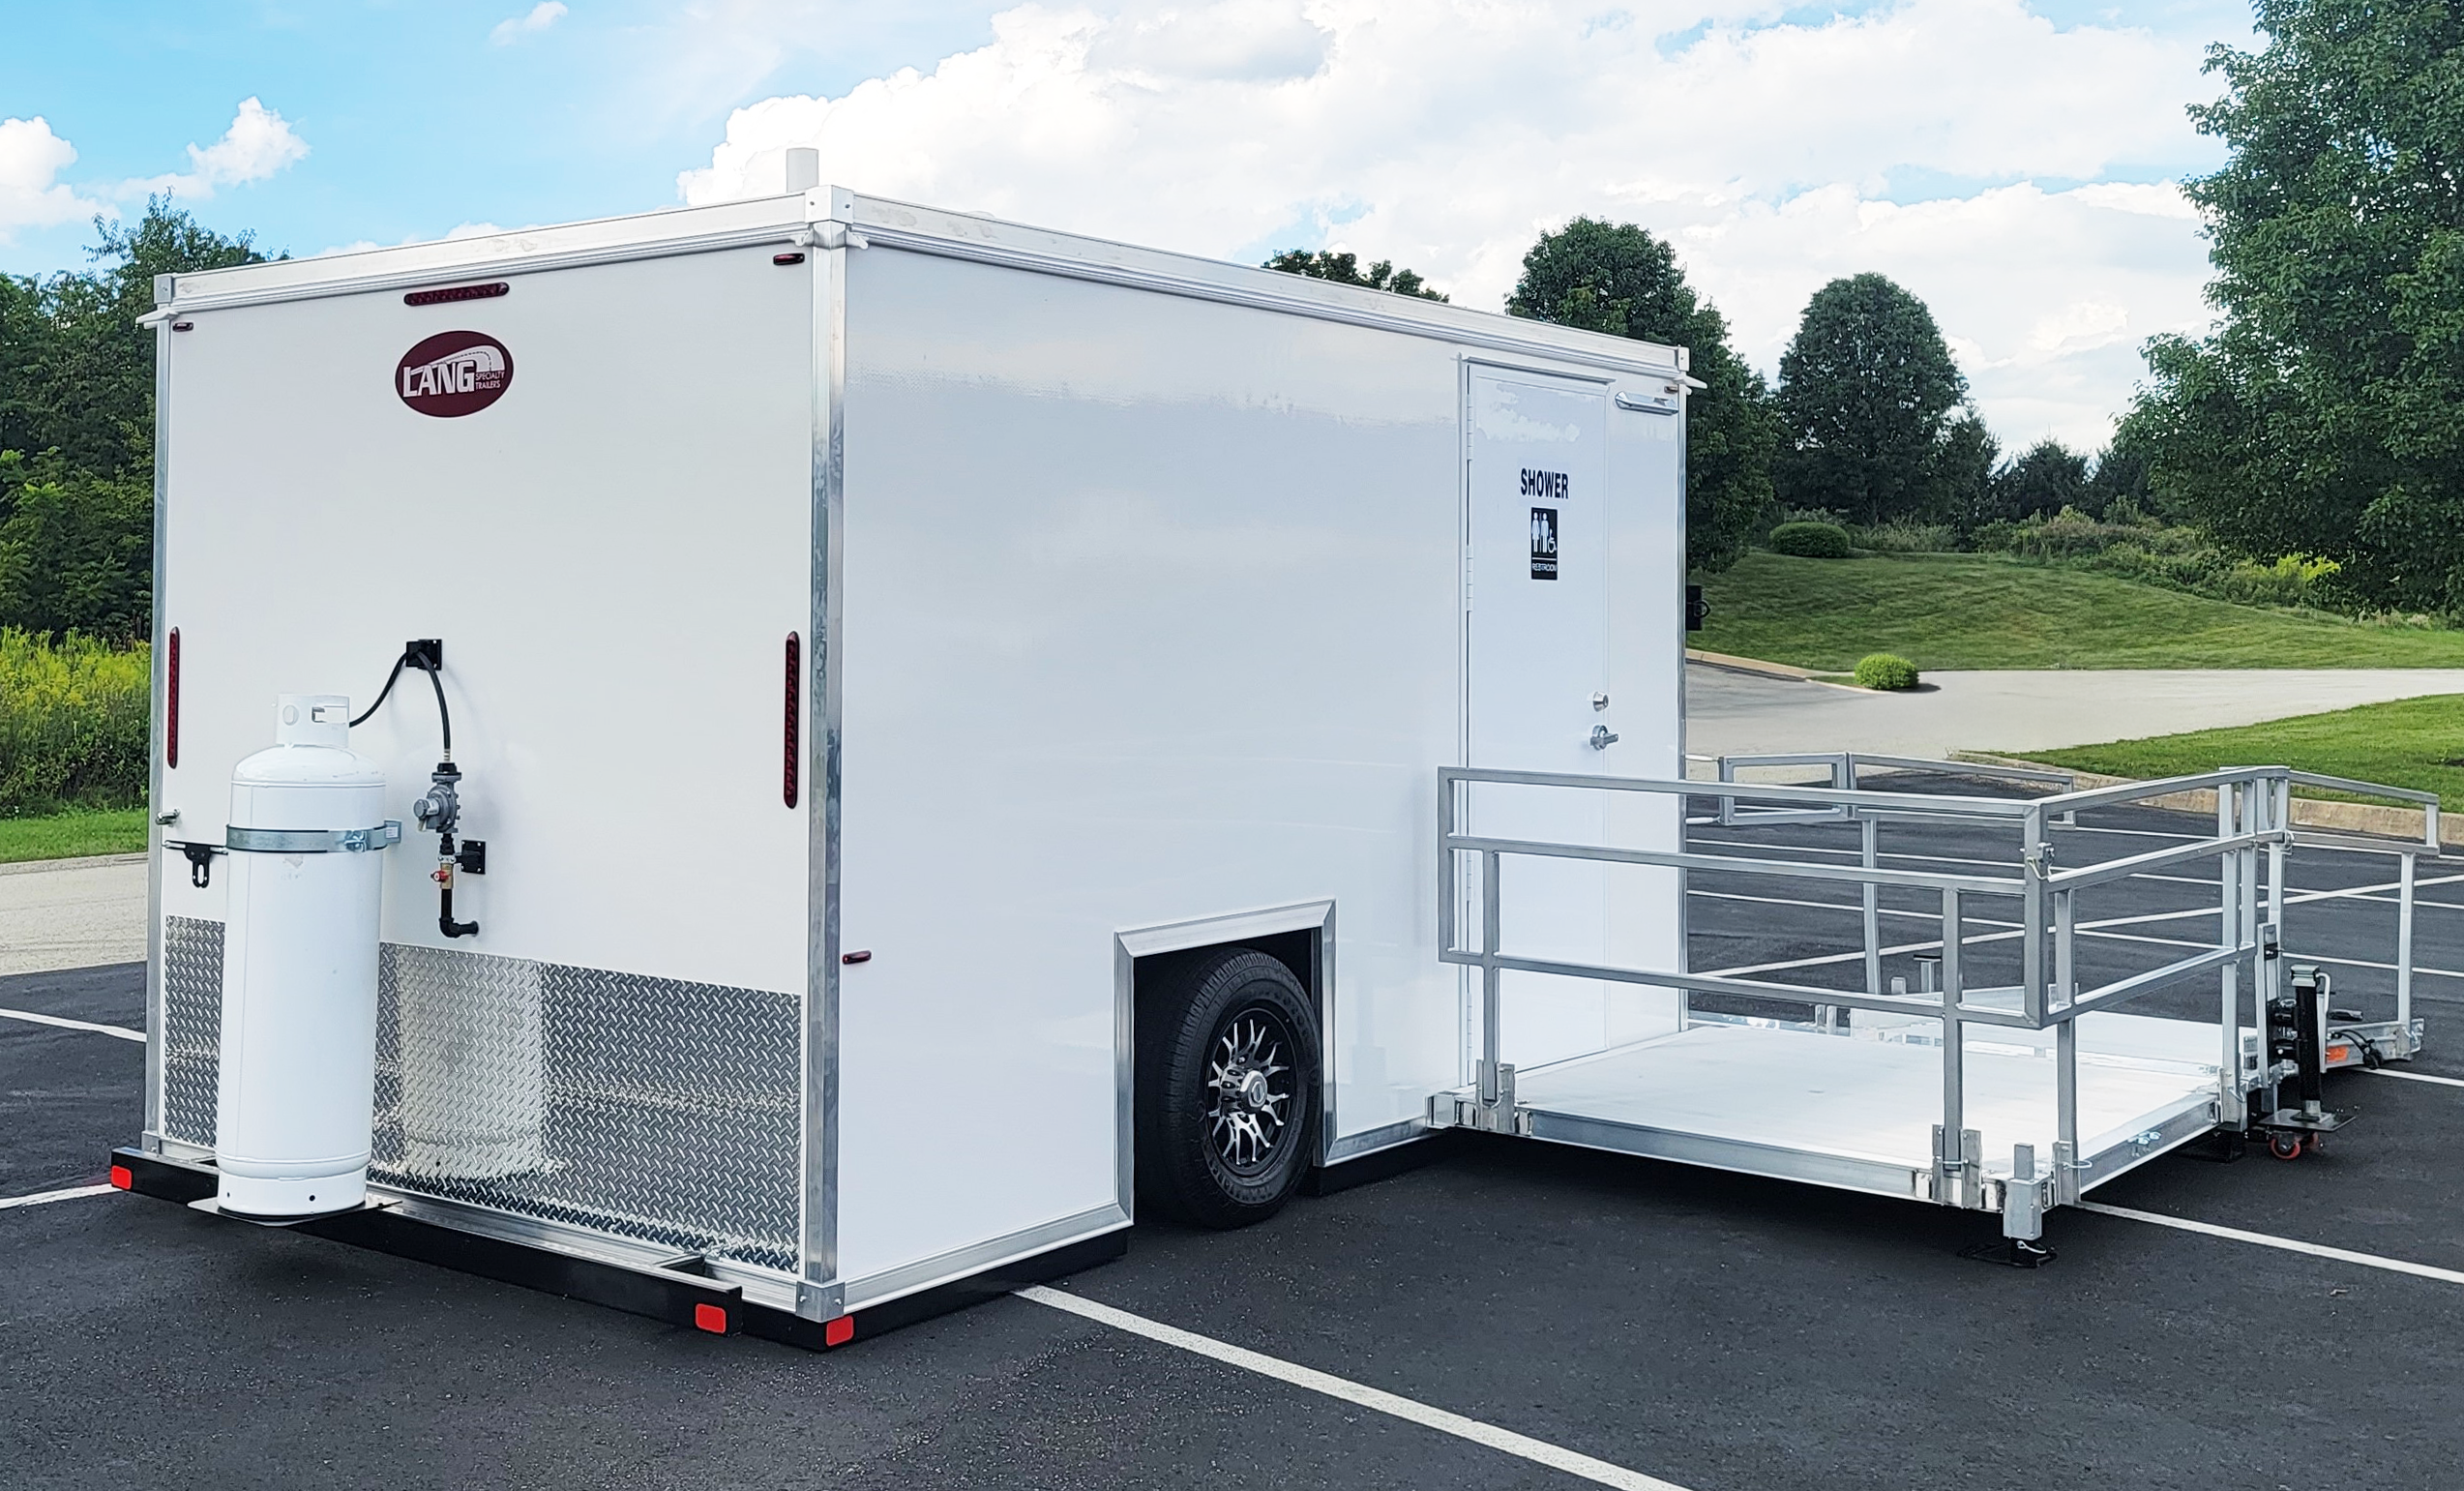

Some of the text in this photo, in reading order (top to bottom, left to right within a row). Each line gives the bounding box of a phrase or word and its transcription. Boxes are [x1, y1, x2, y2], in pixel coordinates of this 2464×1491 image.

[402, 360, 475, 398] LANG
[475, 371, 505, 381] SPECIALTY
[475, 380, 501, 390] TRAILERS
[1521, 467, 1569, 499] SHOWER
